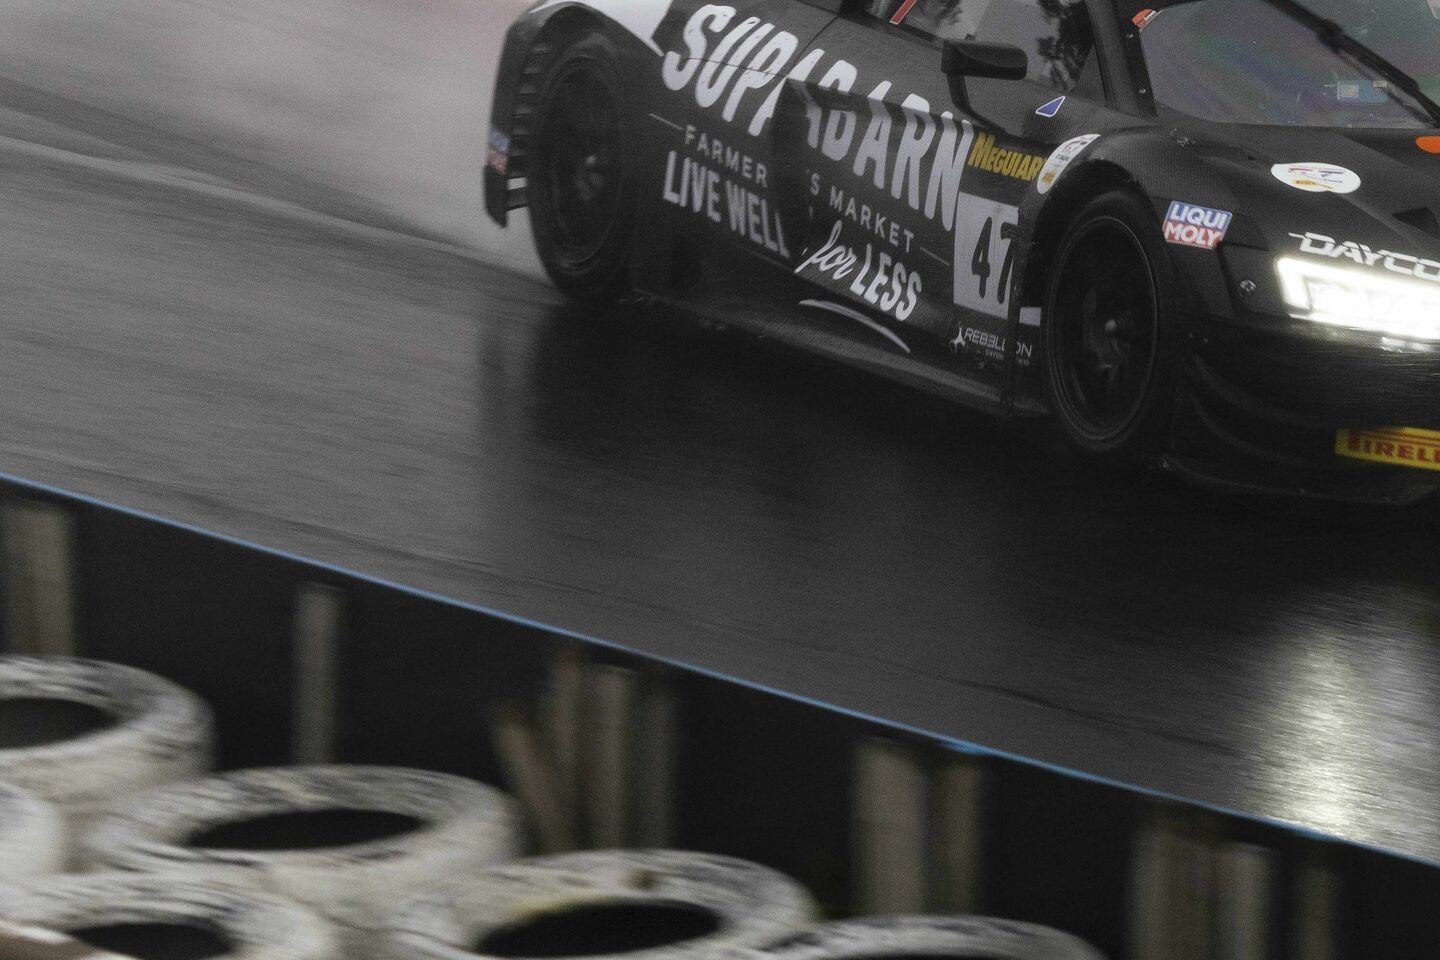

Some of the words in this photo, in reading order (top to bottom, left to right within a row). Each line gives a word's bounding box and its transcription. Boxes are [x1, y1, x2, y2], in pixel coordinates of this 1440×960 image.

[662, 4, 975, 232] SUPABARN
[967, 130, 1046, 182] MEGUIAR
[662, 150, 722, 223] LIVE
[725, 179, 790, 259] WELL
[828, 185, 915, 254] MARKET
[1164, 221, 1222, 247] MOLY
[1170, 203, 1228, 230] LIQUI
[850, 243, 922, 322] LESS
